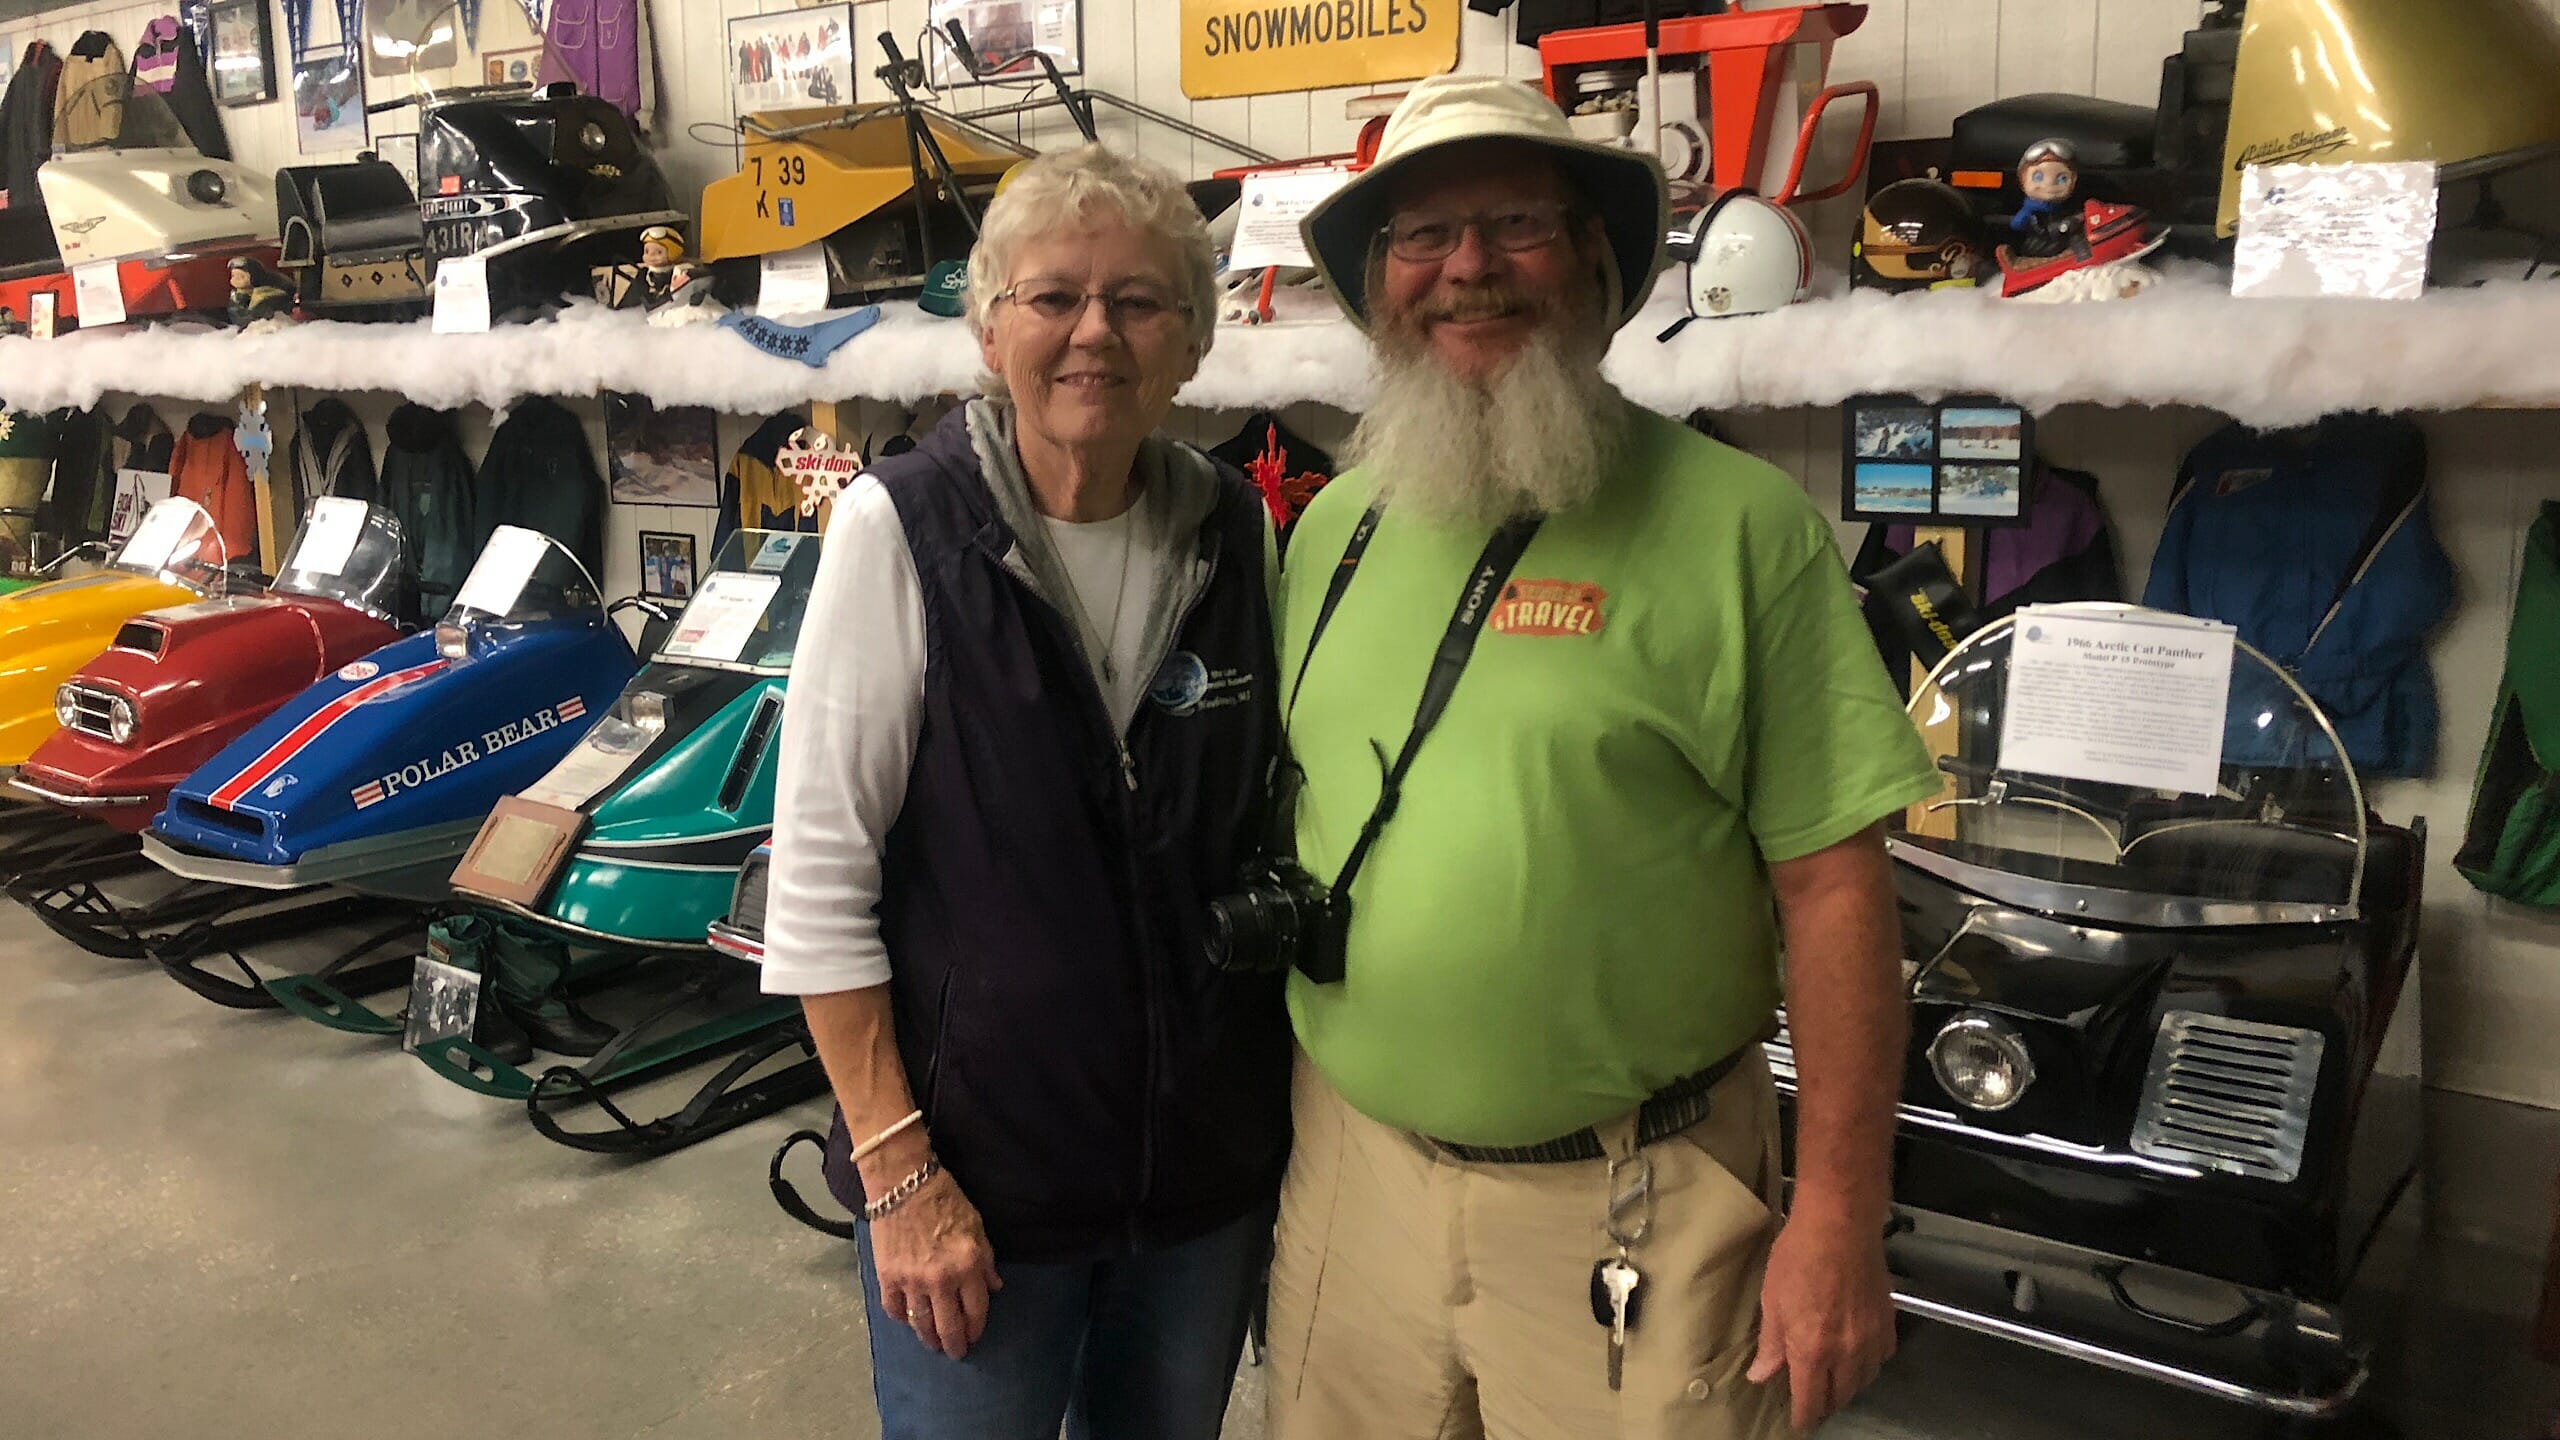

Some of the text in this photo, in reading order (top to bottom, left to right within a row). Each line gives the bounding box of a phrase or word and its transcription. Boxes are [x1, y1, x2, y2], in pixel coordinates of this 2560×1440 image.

[1204, 0, 1427, 56] SNOWMOBILES
[750, 155, 806, 187] 7 39
[755, 189, 770, 218] K
[795, 453, 853, 473] ski-doo
[1460, 565, 1496, 625] SONY
[1506, 600, 1595, 634] TRAVEL
[2066, 637, 2093, 649] 1966
[2095, 640, 2129, 653] Arctic
[2133, 643, 2154, 655] Cat
[2157, 646, 2205, 660] Panther
[381, 708, 559, 797] POLAR BEAR
